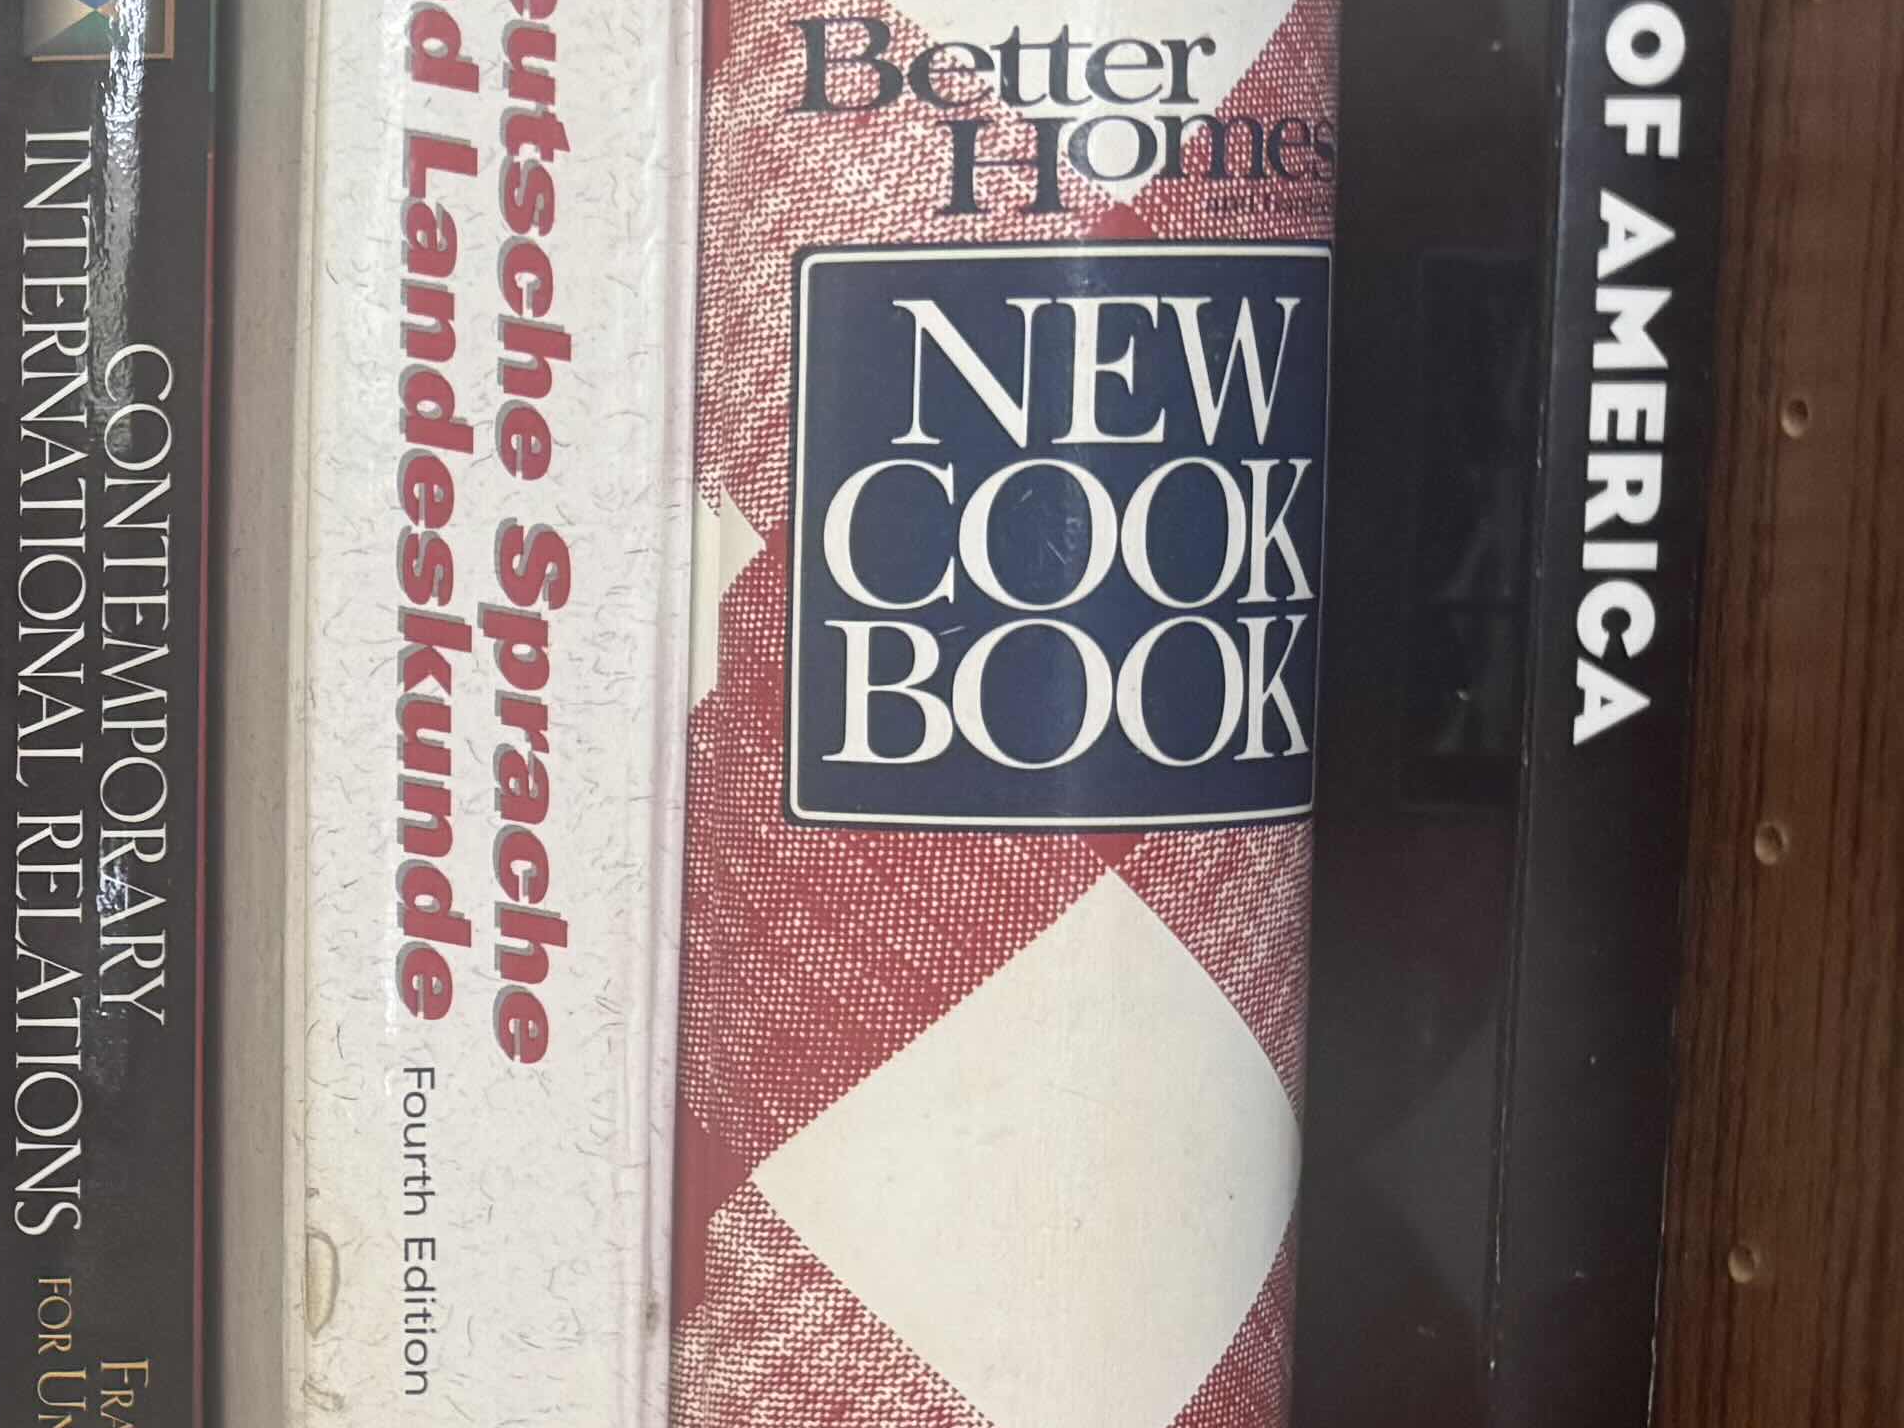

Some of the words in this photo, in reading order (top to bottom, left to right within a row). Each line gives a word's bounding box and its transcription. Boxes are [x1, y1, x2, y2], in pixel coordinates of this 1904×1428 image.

[795, 16, 1217, 114] Better
[1603, 0, 1689, 161] OF
[938, 110, 1338, 218] Homes
[891, 294, 1302, 449] NEW
[15, 127, 93, 788] INTERNATIONAL
[821, 455, 1317, 612] COOK
[1572, 188, 1678, 748] AMERICA
[394, 126, 481, 1023] Landeskunde
[96, 342, 175, 1027] CONTEMPORARY
[821, 613, 1313, 771] BOOK
[477, 515, 573, 1065] Sprache
[12, 808, 85, 1238] RELATIONS
[36, 1274, 73, 1357] FOR
